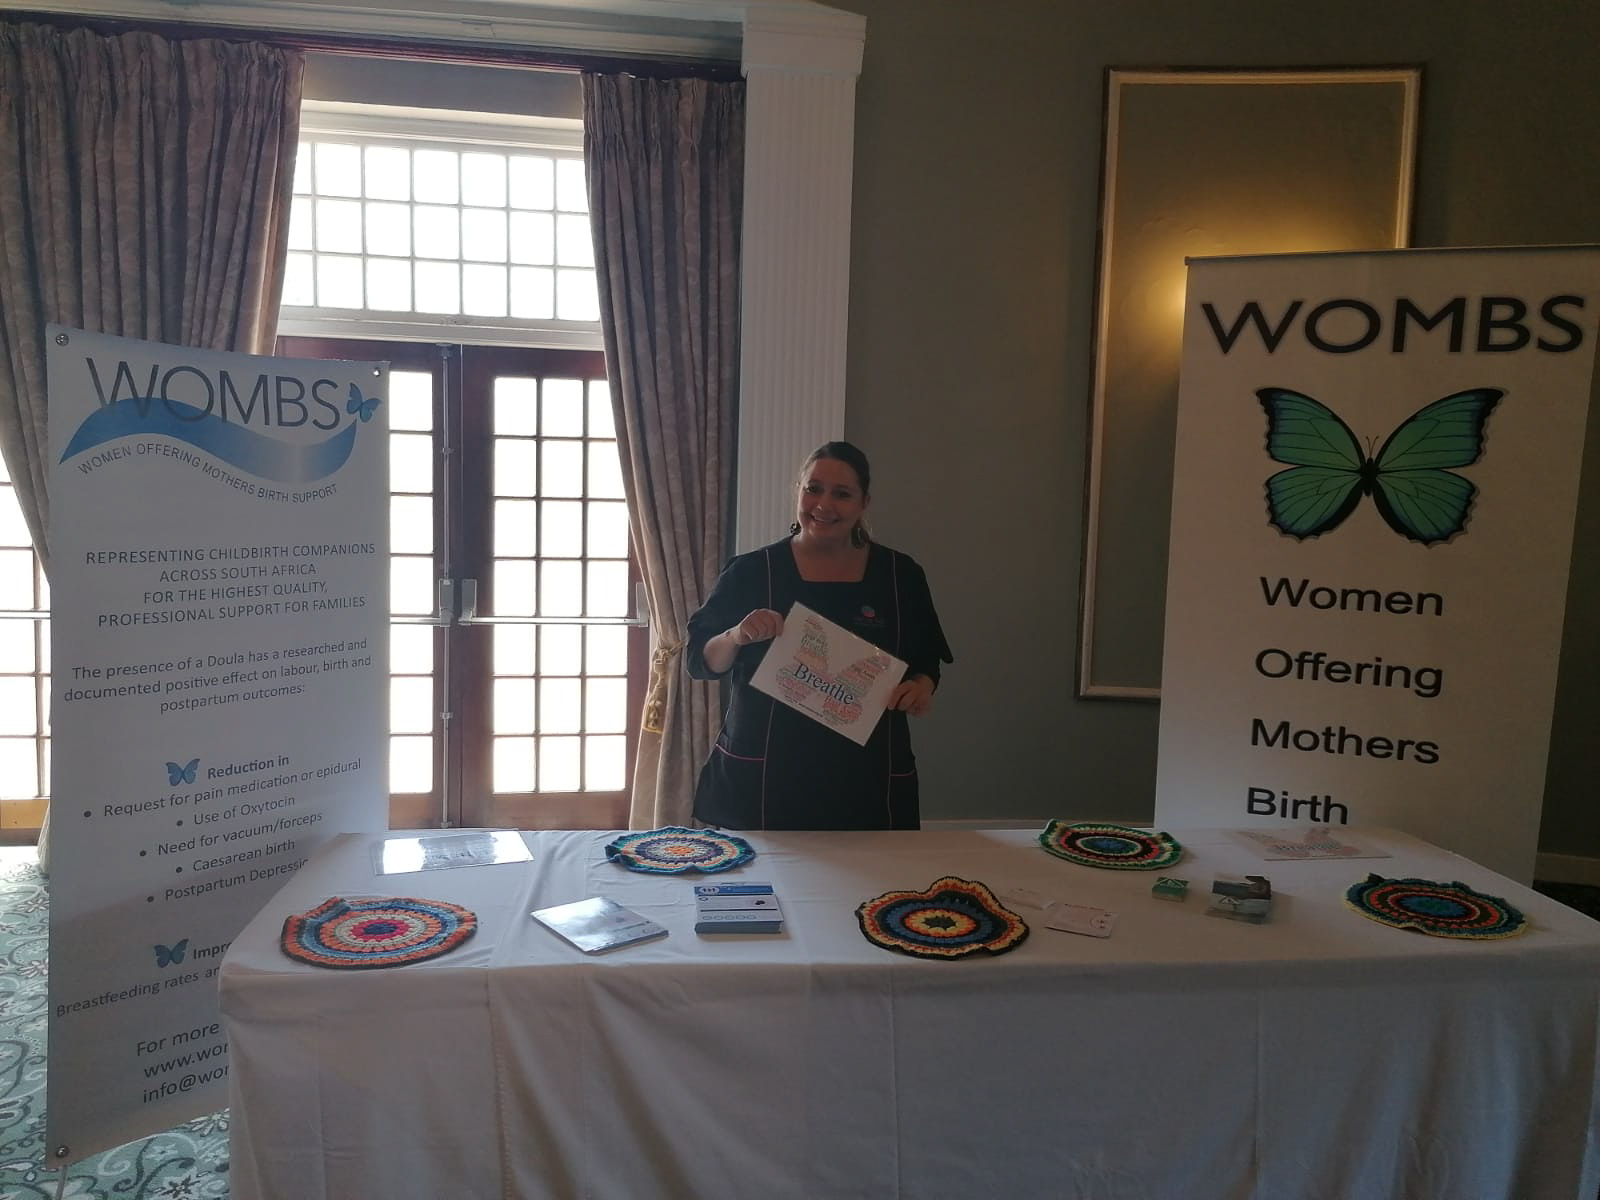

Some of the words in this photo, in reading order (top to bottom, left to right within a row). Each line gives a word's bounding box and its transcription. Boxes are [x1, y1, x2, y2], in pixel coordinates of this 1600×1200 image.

[1202, 295, 1585, 355] WOMBS
[86, 357, 340, 430] WOMBS
[78, 445, 131, 475] WOMEN
[136, 443, 201, 468] OFFERING
[202, 462, 255, 495] MOTHERS
[258, 487, 289, 503] BIRTH
[291, 483, 338, 503] SUPPORT
[86, 549, 205, 565] REPRESENTING
[209, 546, 289, 560] CHILDBIRTH
[293, 543, 375, 557] COMPANIONS
[160, 567, 217, 583] ACROSS
[221, 565, 267, 579] SOUTH
[271, 563, 316, 576] AFRICA
[98, 608, 215, 627] PROFESSIONAL
[219, 603, 280, 619] SUPPORT
[284, 601, 309, 613] FOR
[313, 596, 365, 611] FAMILIES
[144, 591, 174, 605] FOR
[180, 589, 207, 602] THE
[211, 584, 268, 599] HIGHEST
[1259, 576, 1444, 616] Women
[64, 681, 161, 702] documented
[165, 675, 219, 695] positive
[222, 670, 258, 685] effect
[262, 669, 277, 680] on
[280, 663, 320, 678] labour,
[323, 658, 348, 672] birth
[352, 656, 371, 668] and
[72, 666, 101, 680] The
[106, 660, 174, 680] presence
[177, 657, 192, 671] of
[196, 659, 203, 668] a
[207, 653, 244, 668] Doula
[248, 649, 269, 663] has
[272, 650, 279, 660] a
[283, 641, 344, 659] researched
[348, 639, 367, 650] and
[1255, 647, 1443, 698] Offering
[160, 692, 239, 715] postpartum
[243, 684, 305, 701] outcomes:
[794, 663, 853, 704] Breathe
[1251, 717, 1440, 764] Mothers
[208, 757, 274, 779] Reduction
[278, 755, 289, 767] in
[104, 797, 165, 817] Request
[170, 794, 190, 806] for
[195, 787, 223, 804] pain
[227, 772, 298, 795] medication
[301, 771, 313, 781] or
[317, 758, 361, 779] epidural
[1246, 786, 1349, 826] Birth
[194, 810, 219, 825] Use
[224, 806, 237, 819] of
[240, 795, 295, 817] Oxytocin
[158, 838, 196, 855] Need
[200, 833, 219, 847] for
[223, 811, 322, 842] vacuum/forceps
[193, 848, 262, 871] Caesarean
[266, 839, 295, 856] birth
[165, 874, 245, 901] Postpartum
[56, 980, 160, 1017] Breastfeeding
[164, 973, 198, 989] rates
[136, 1039, 167, 1056] For
[172, 1024, 220, 1046] more
[144, 1043, 229, 1078] www.wo
[143, 1065, 229, 1103] info@wo
